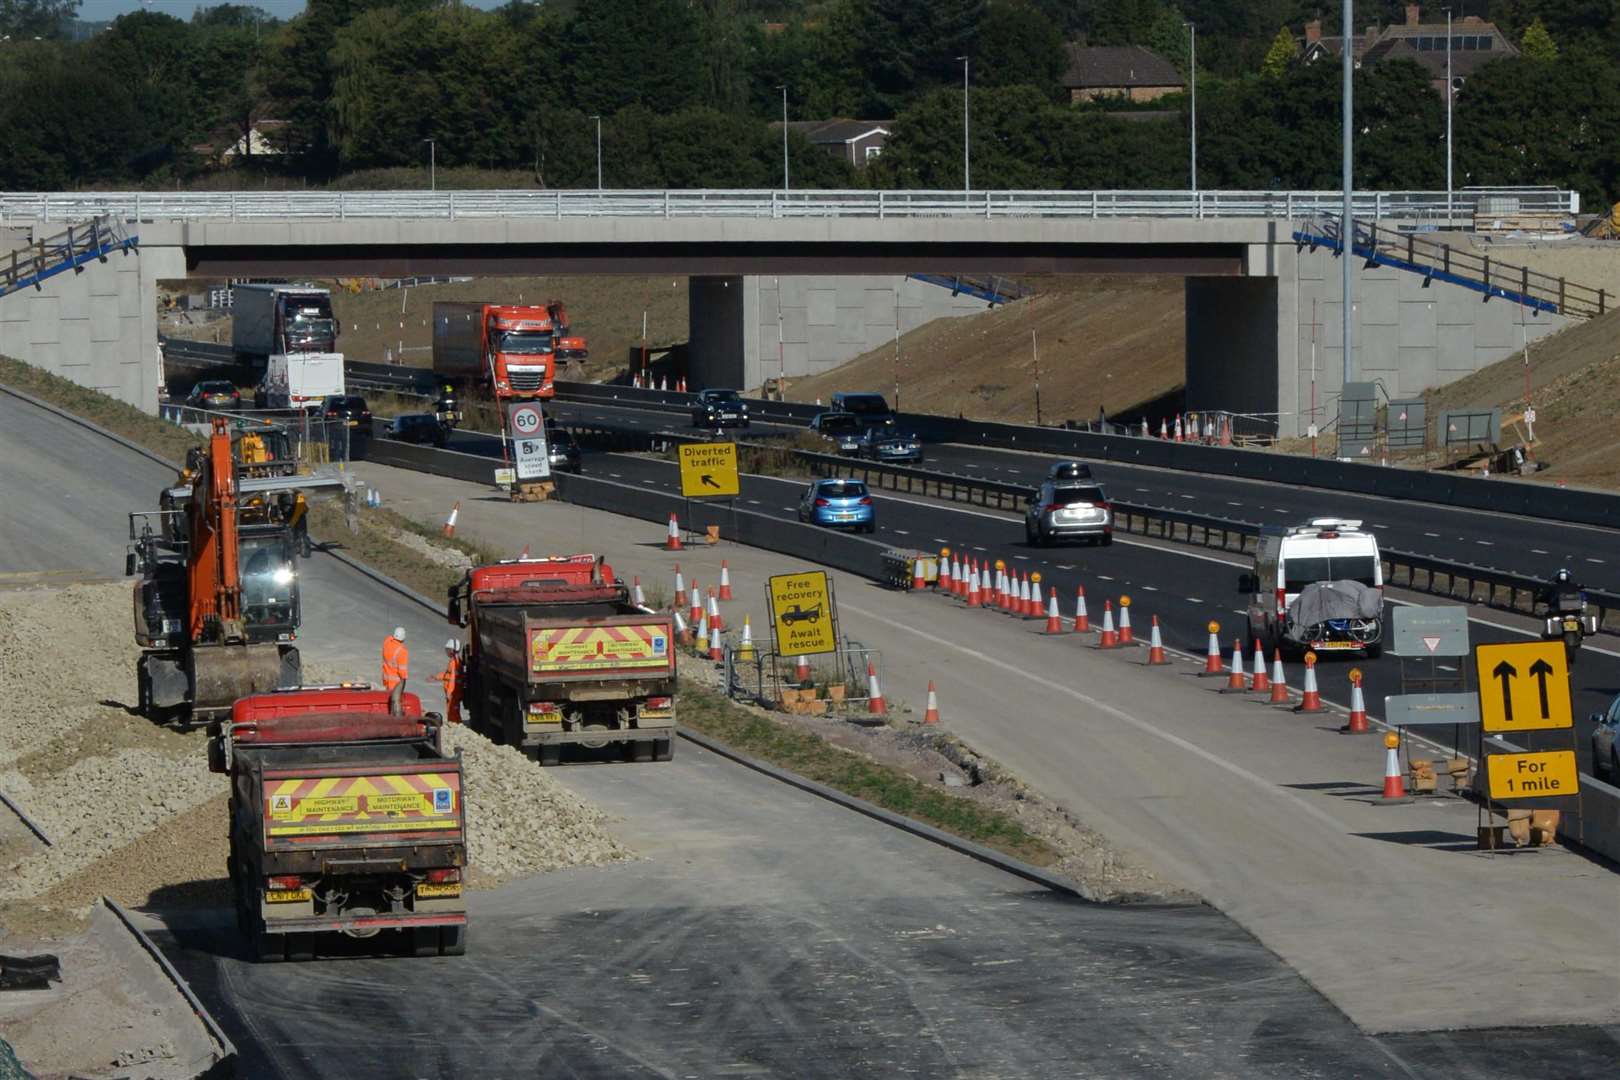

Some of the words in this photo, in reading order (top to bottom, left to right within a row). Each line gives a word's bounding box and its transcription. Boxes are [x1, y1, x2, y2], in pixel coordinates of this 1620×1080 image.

[516, 414, 538, 427] 60
[684, 446, 731, 457] Diverted
[691, 457, 726, 467] traffic
[786, 580, 810, 590] Free
[776, 590, 824, 601] recovery
[790, 628, 822, 639] Await
[788, 639, 825, 649] rescue
[1517, 759, 1547, 774] For
[1507, 778, 1514, 792] 1
[1521, 777, 1560, 791] mile
[313, 798, 346, 806] HIGHWAY
[376, 796, 417, 804] MOTORWAY
[305, 804, 353, 813] MAINTENANCE
[371, 802, 420, 811] MAINTENANCE
